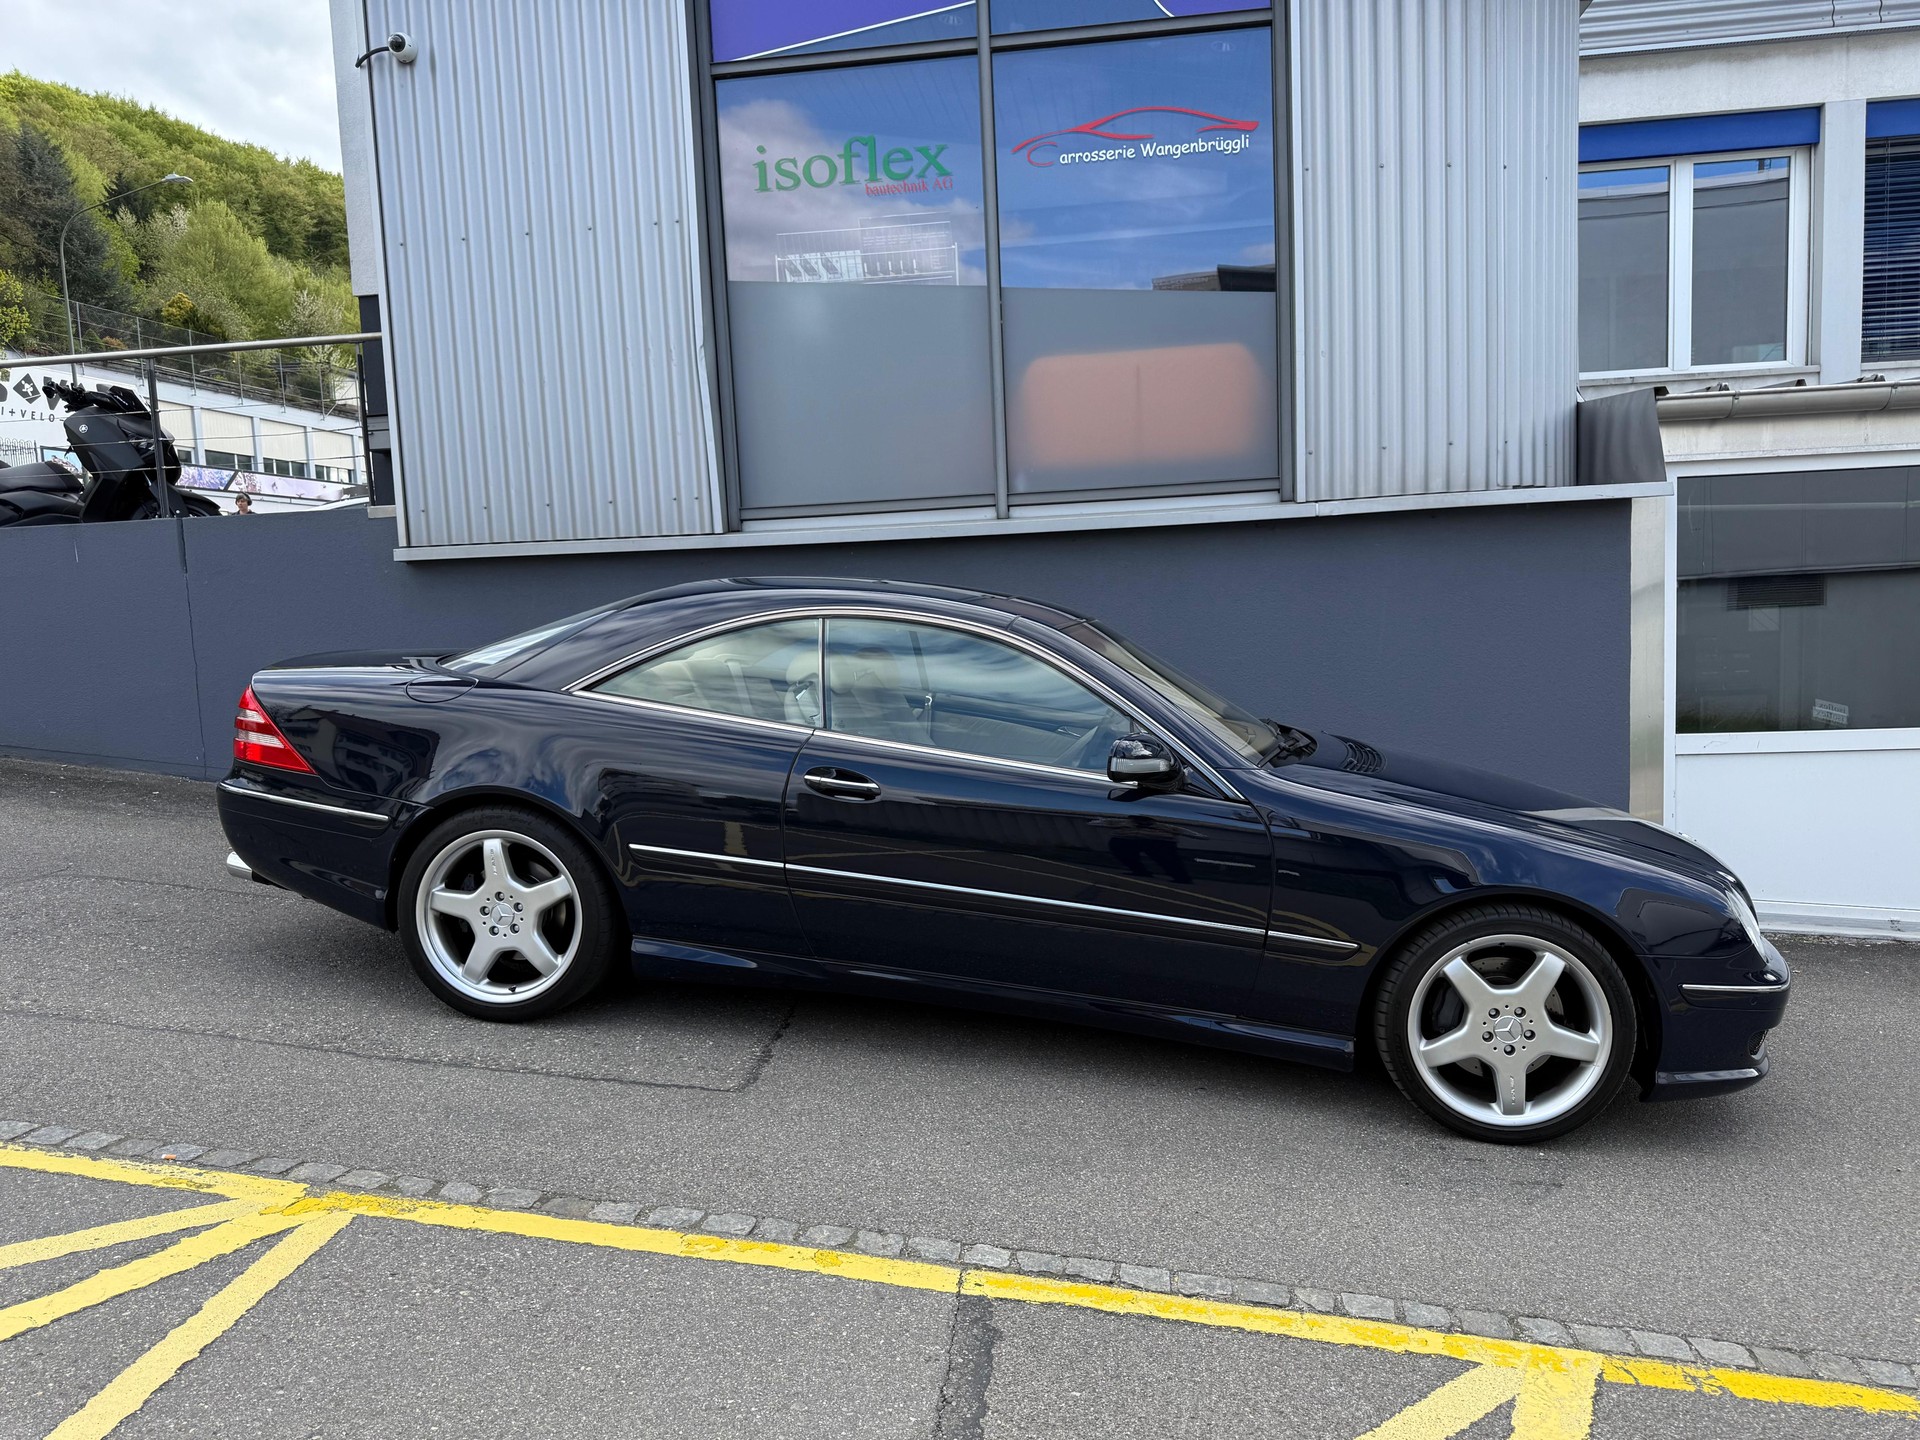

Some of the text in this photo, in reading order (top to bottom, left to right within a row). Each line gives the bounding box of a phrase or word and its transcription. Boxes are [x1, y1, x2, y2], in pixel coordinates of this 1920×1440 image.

[1140, 135, 1250, 158] Wangenbrüggli
[752, 134, 953, 192] isoflex
[865, 176, 953, 196] bautechnik AG
